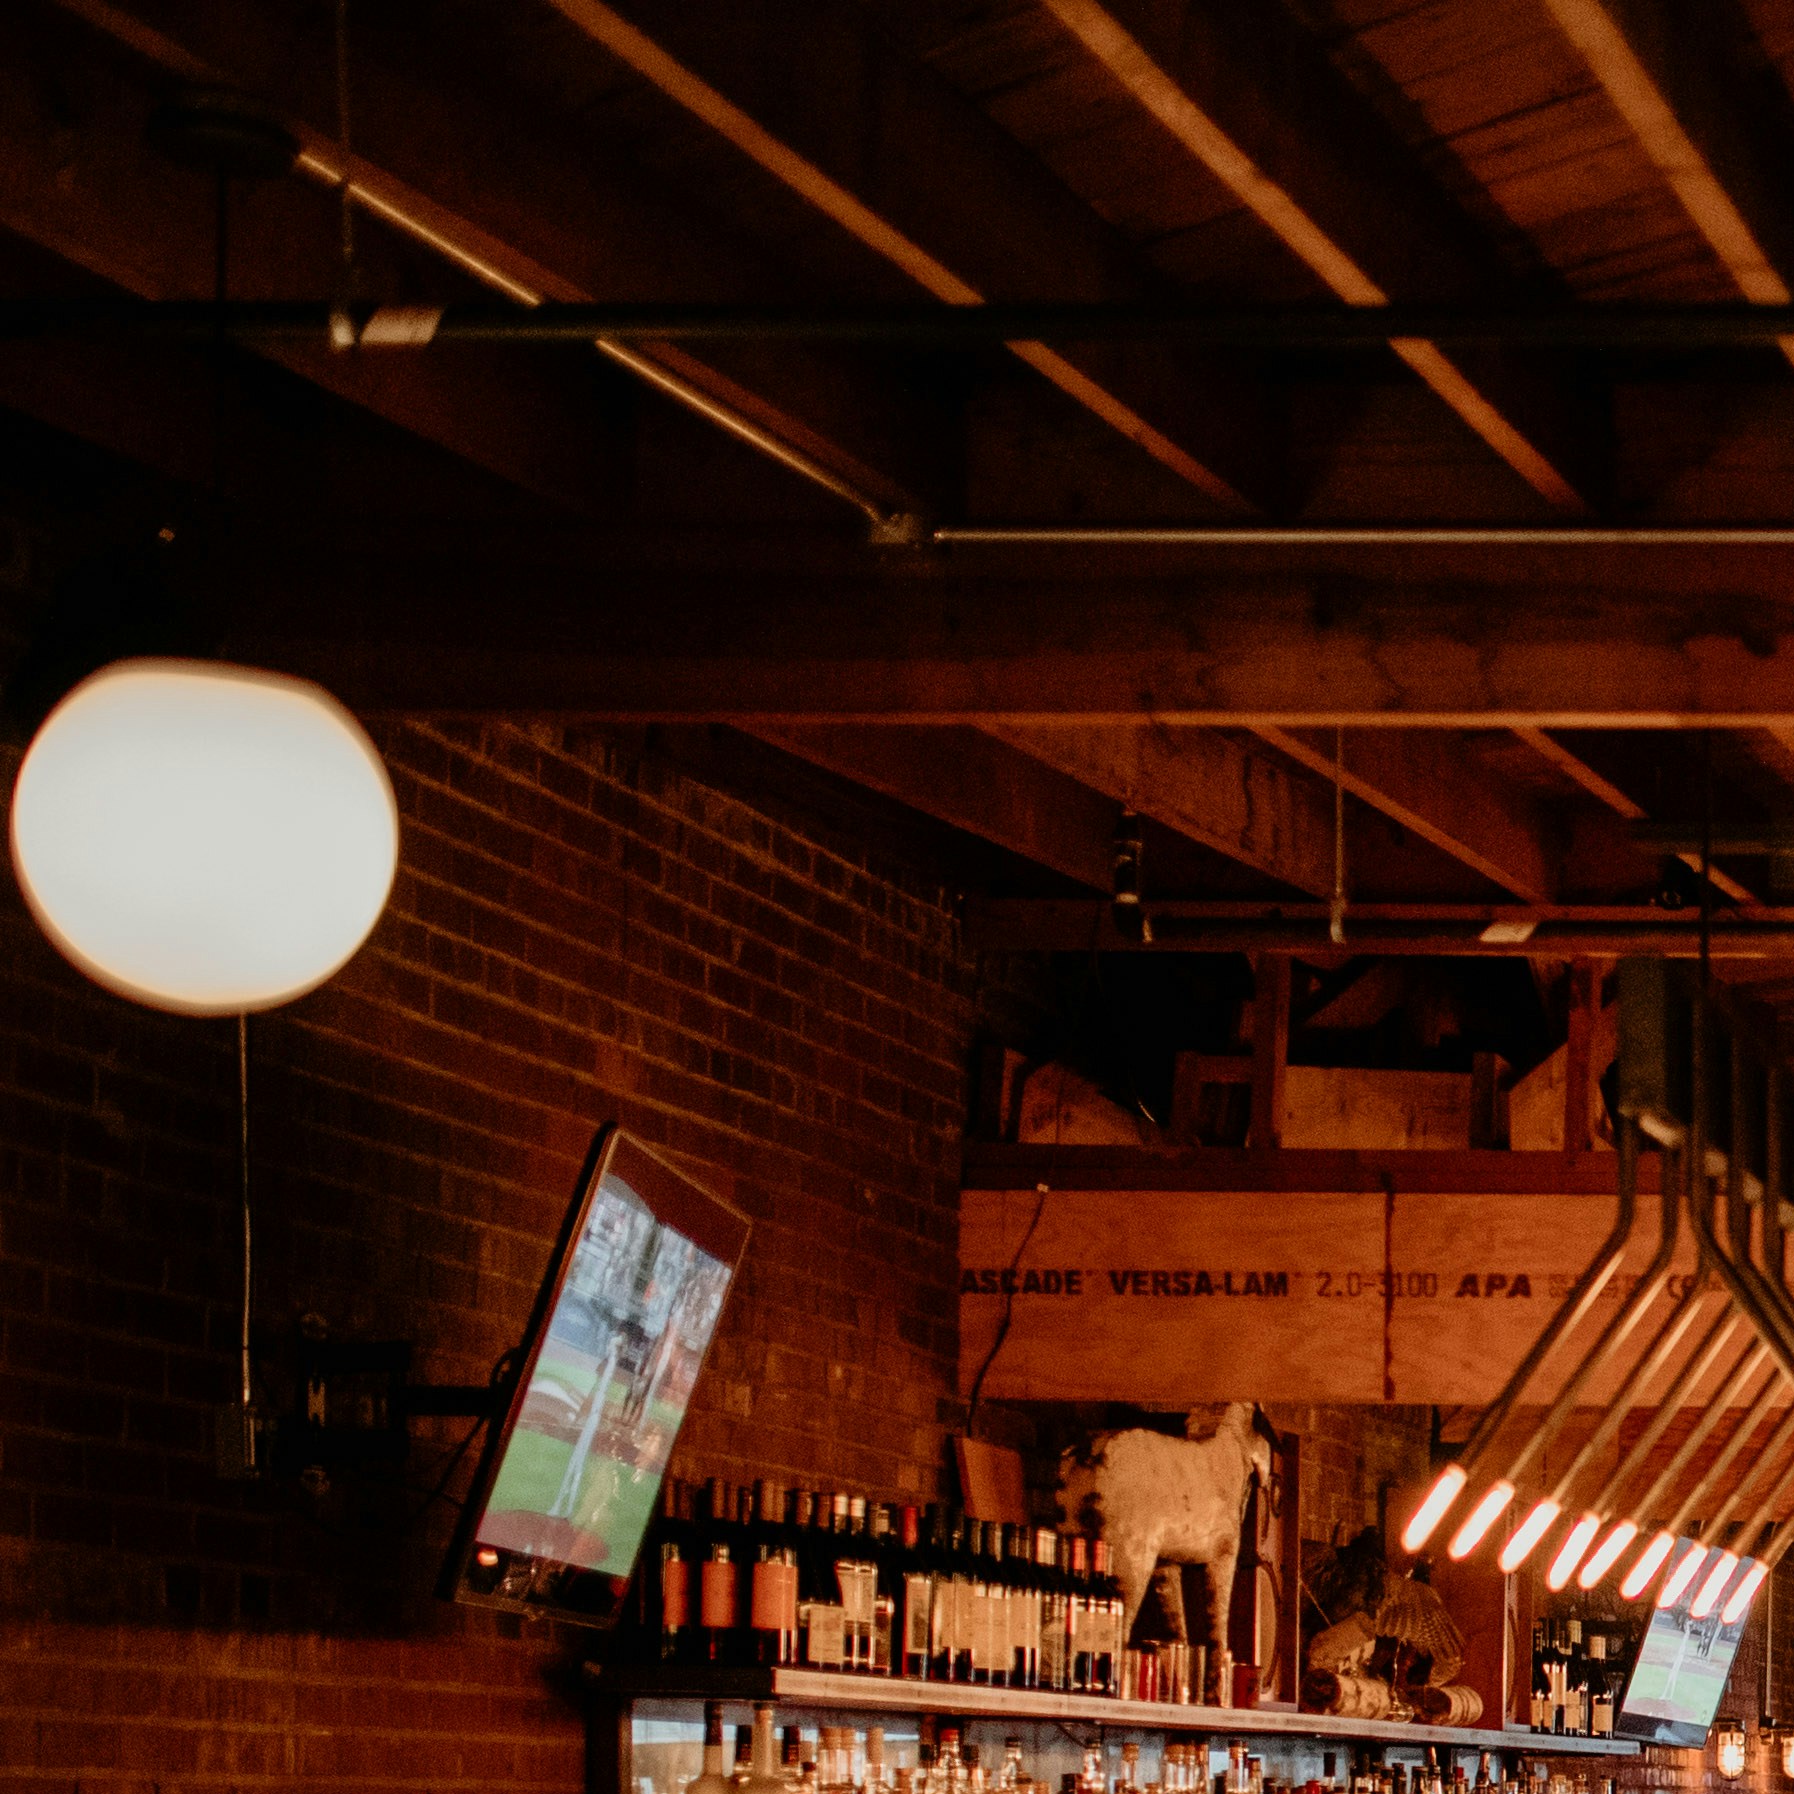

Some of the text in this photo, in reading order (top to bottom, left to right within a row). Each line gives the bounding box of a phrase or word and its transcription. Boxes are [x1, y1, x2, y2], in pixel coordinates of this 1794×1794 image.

[960, 1269, 1082, 1295] ASCADE
[1108, 1270, 1289, 1297] VERSA-LAM
[1455, 1273, 1533, 1299] APA
